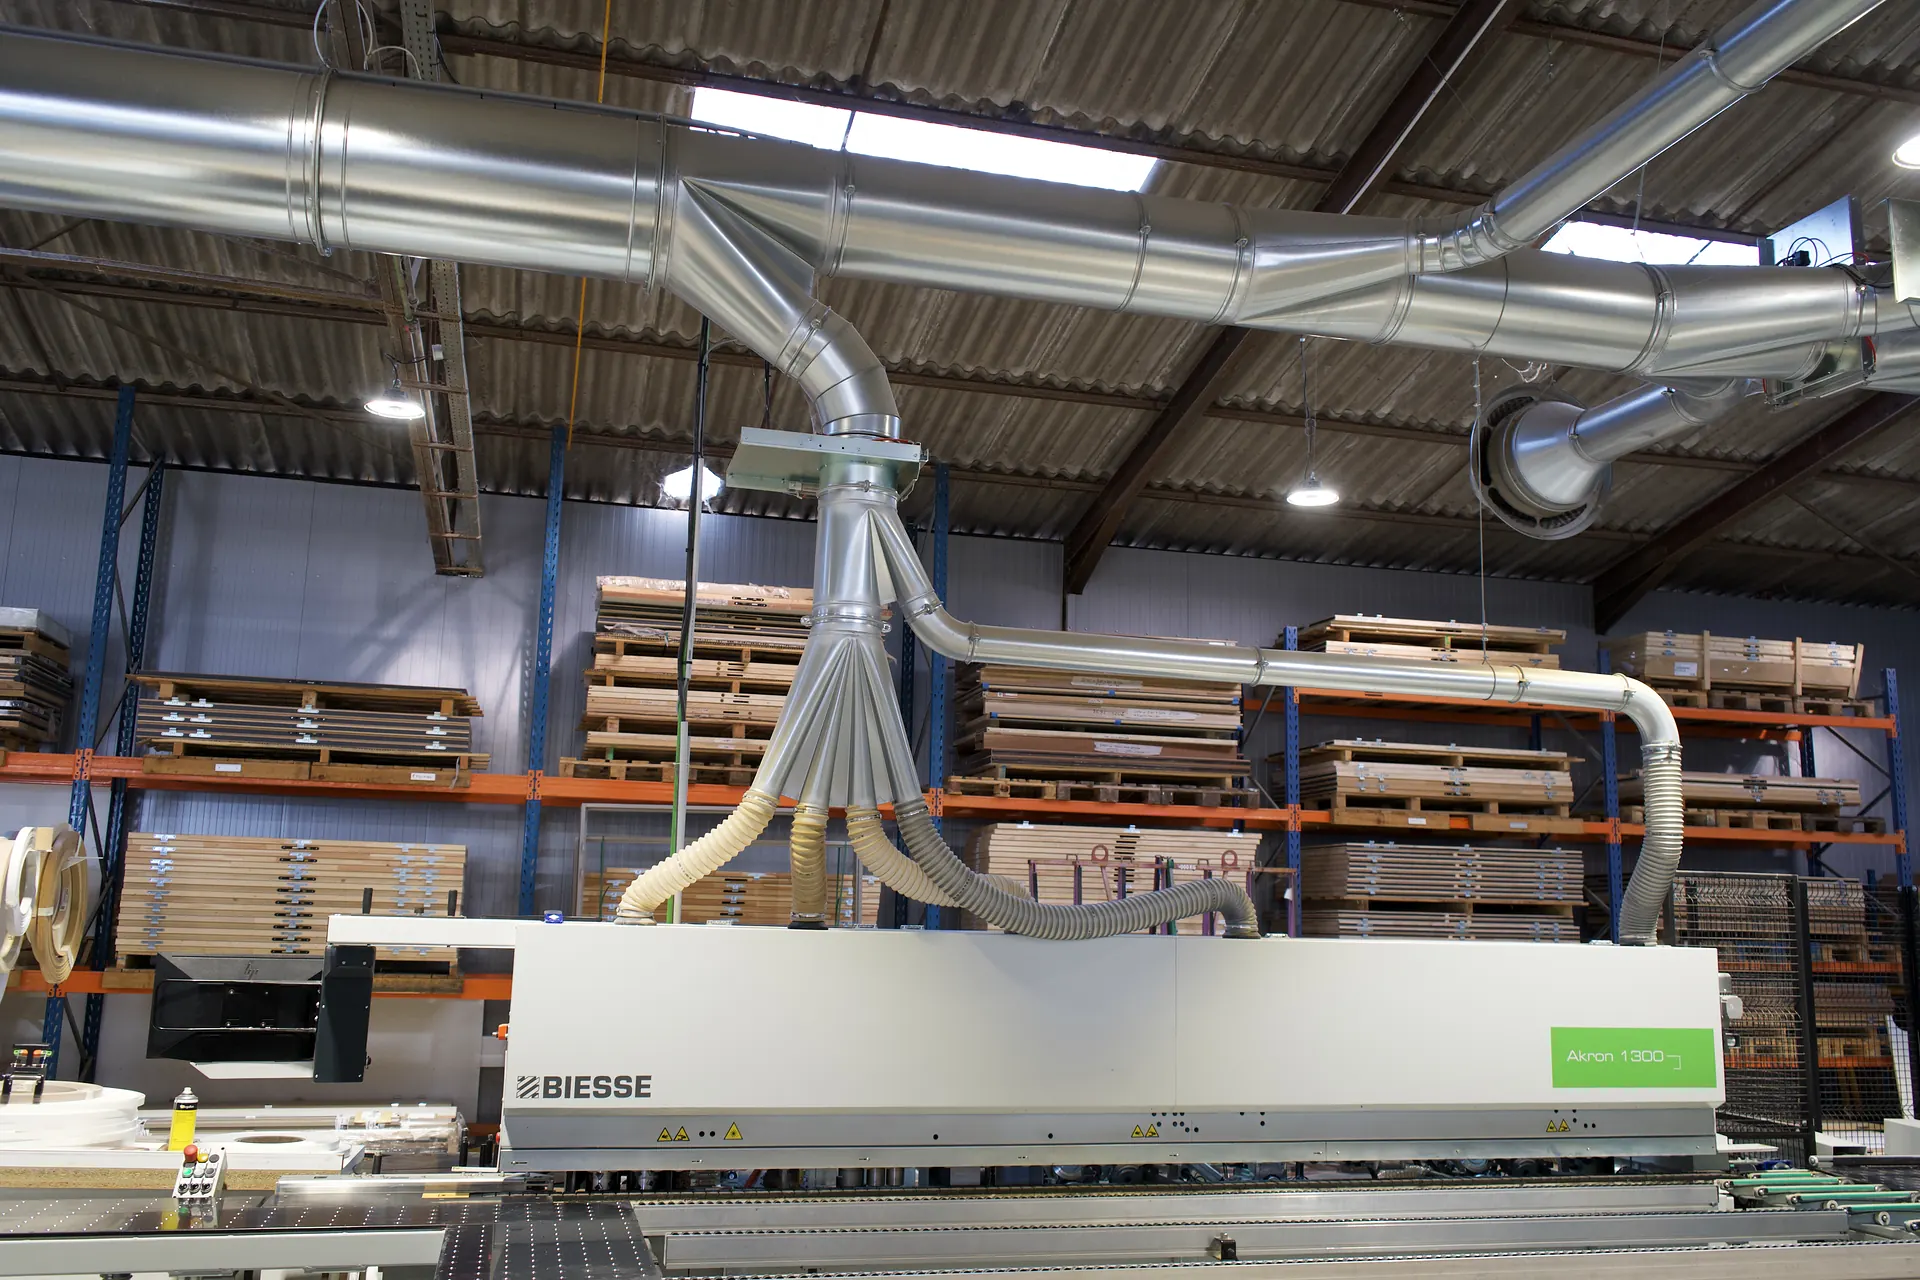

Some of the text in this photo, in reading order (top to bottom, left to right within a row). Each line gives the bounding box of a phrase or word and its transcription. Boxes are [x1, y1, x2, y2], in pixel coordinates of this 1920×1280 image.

[1566, 1049, 1664, 1063] Akron 1300
[543, 1075, 652, 1099] BIESSE
